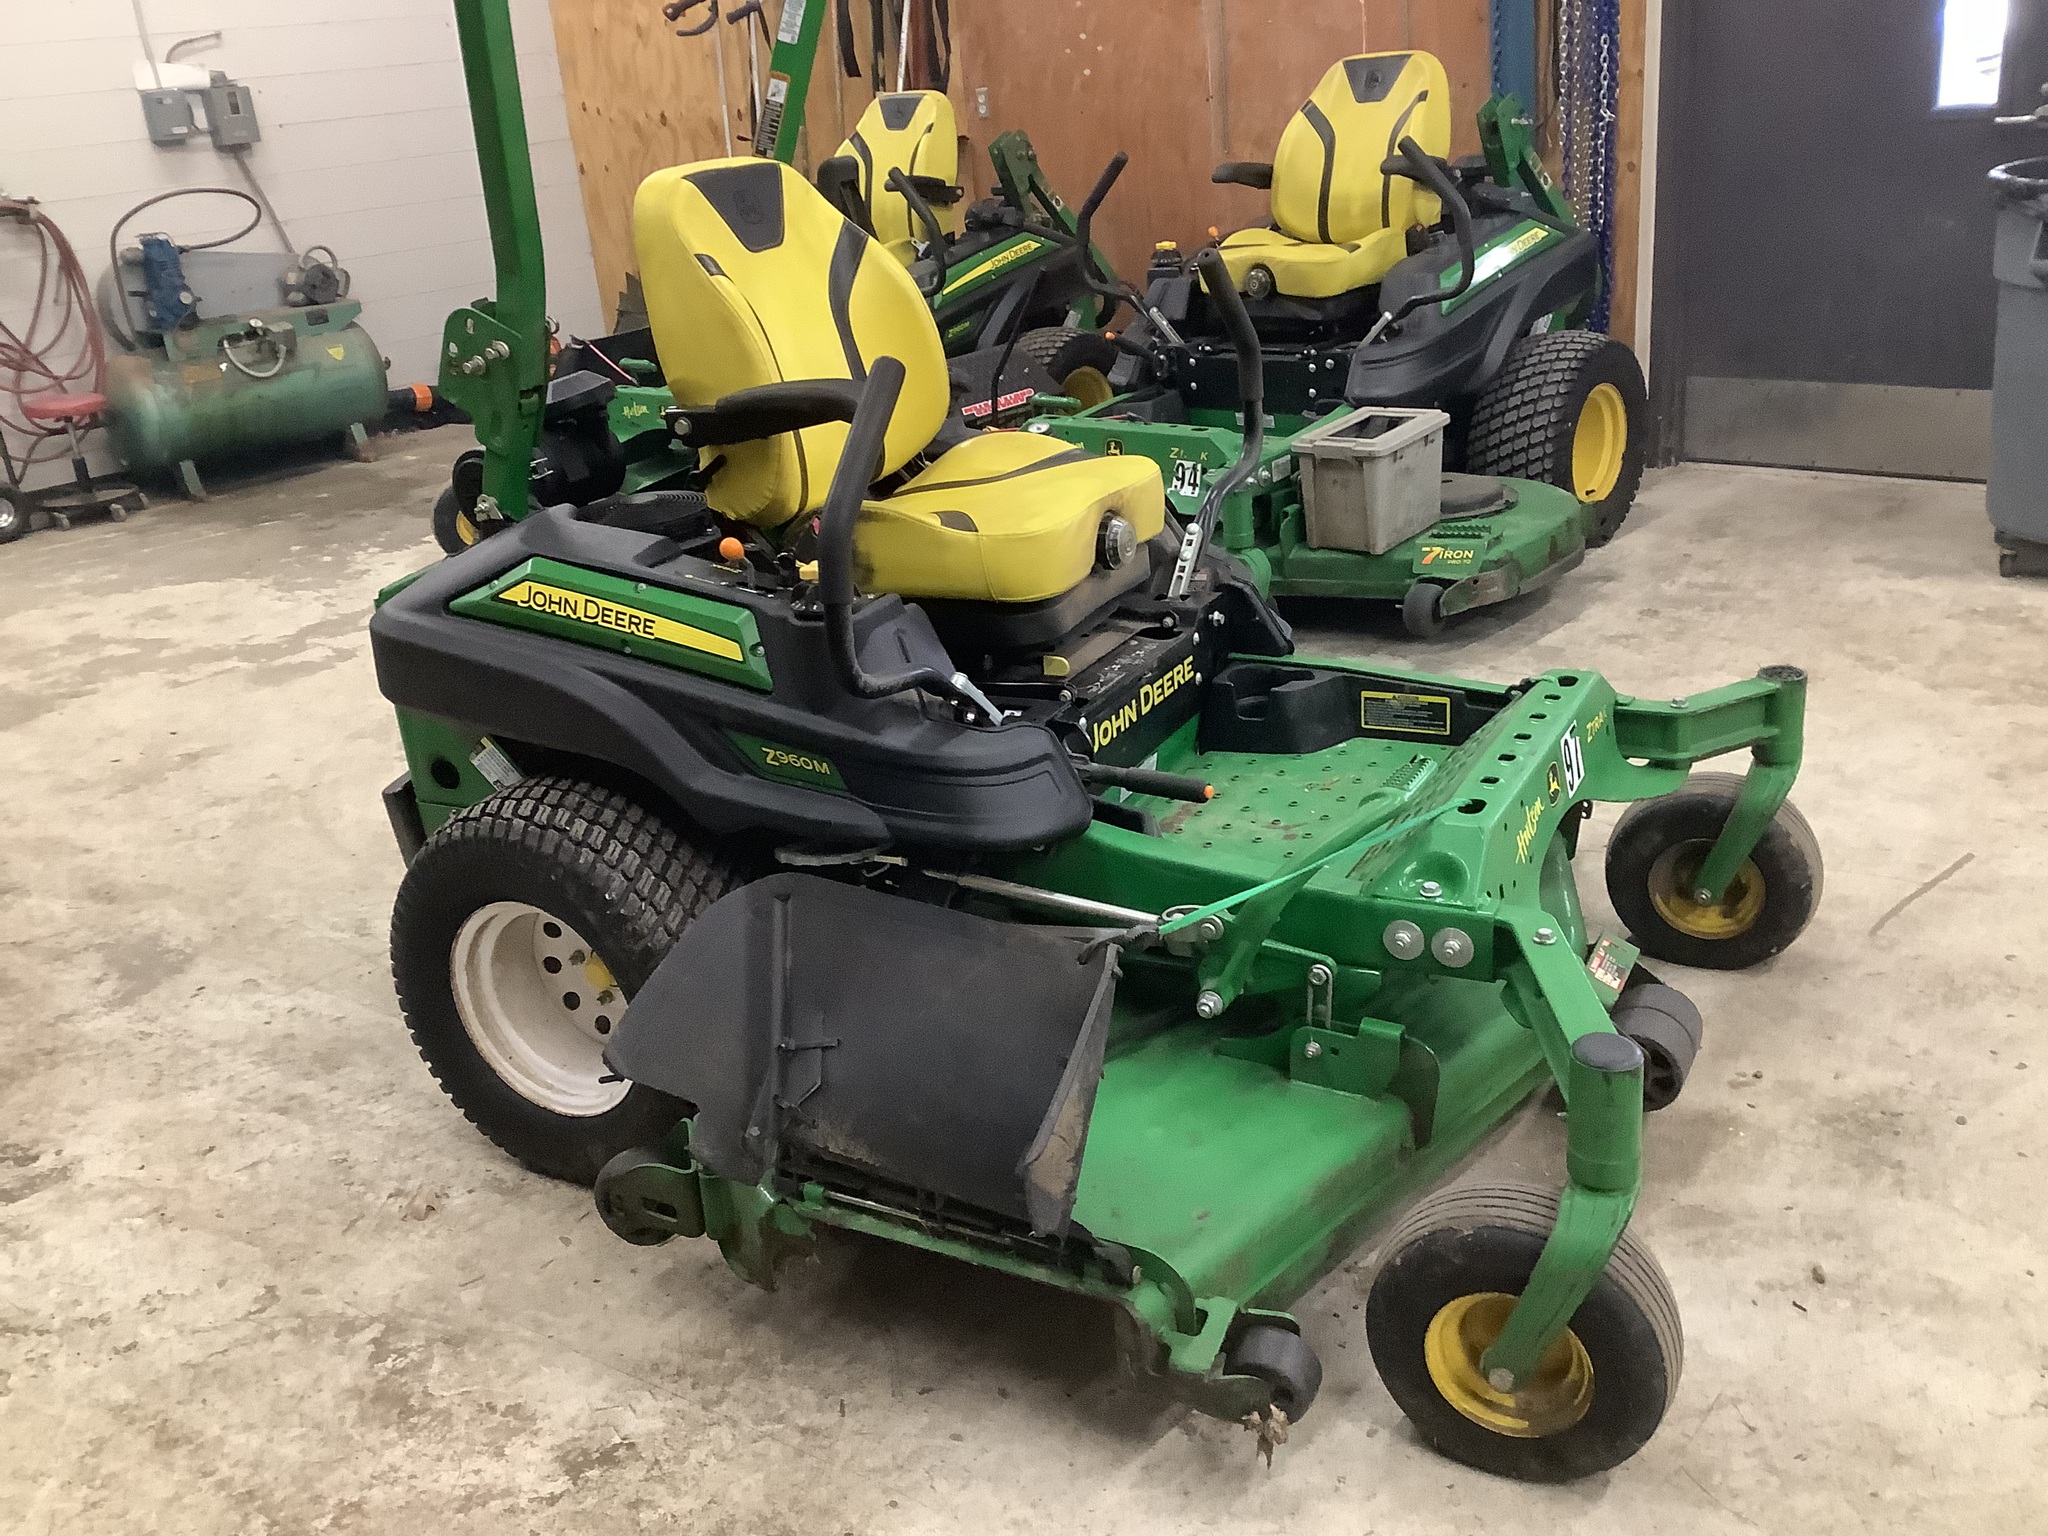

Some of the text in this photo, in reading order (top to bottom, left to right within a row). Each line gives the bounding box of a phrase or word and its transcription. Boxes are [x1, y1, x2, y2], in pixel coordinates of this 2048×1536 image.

[990, 243, 1033, 269] JOHN DEERE
[1174, 462, 1199, 495] 94
[520, 585, 656, 637] JOHN DEERE
[1093, 654, 1195, 754] JOHN DEERE
[761, 746, 831, 775] Z960M
